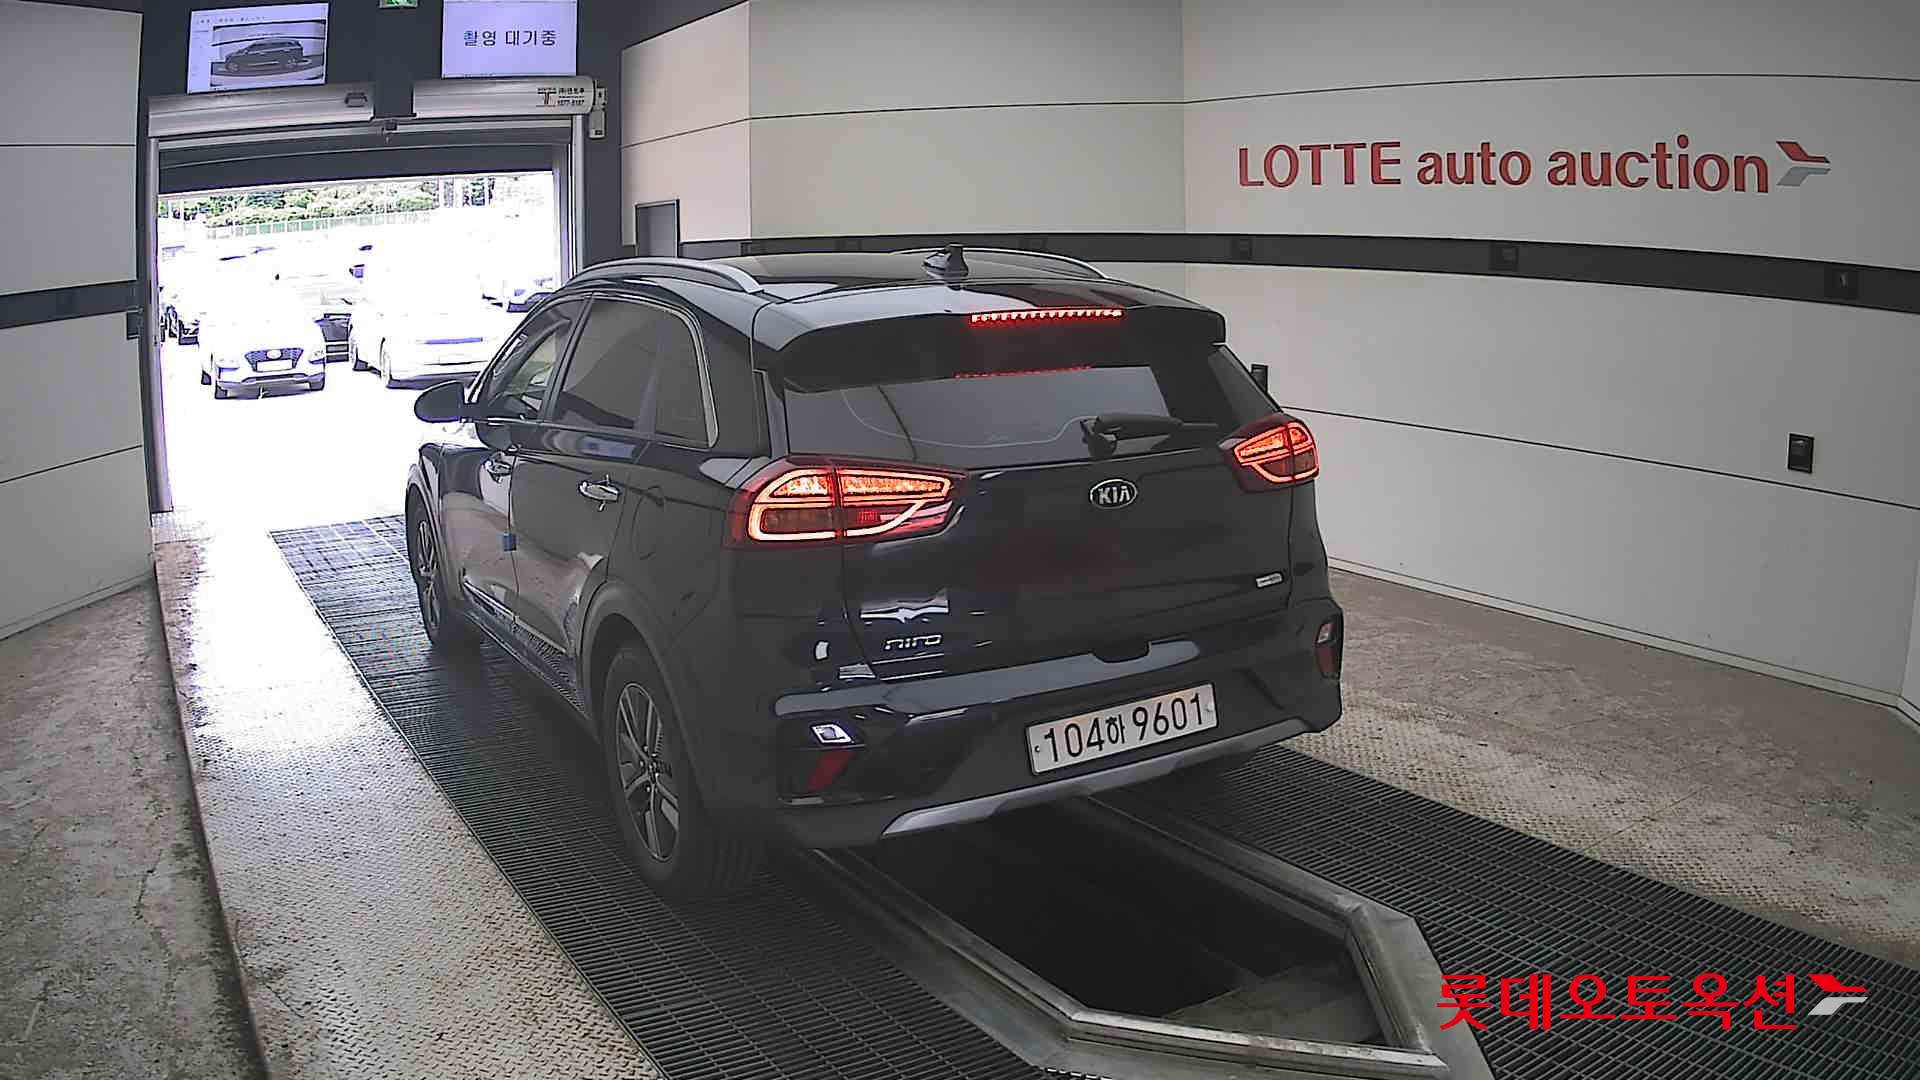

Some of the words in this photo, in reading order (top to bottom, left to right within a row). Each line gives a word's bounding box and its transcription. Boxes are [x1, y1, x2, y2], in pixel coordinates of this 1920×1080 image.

[463, 30, 497, 47] 촬영
[504, 30, 558, 46] 대기중
[1238, 142, 1402, 188] LOTTE
[1417, 141, 1532, 187] auto
[1547, 134, 1770, 194] auction
[1098, 485, 1131, 504] KIA
[1043, 713, 1126, 763] 104하
[1131, 692, 1203, 741] 9601
